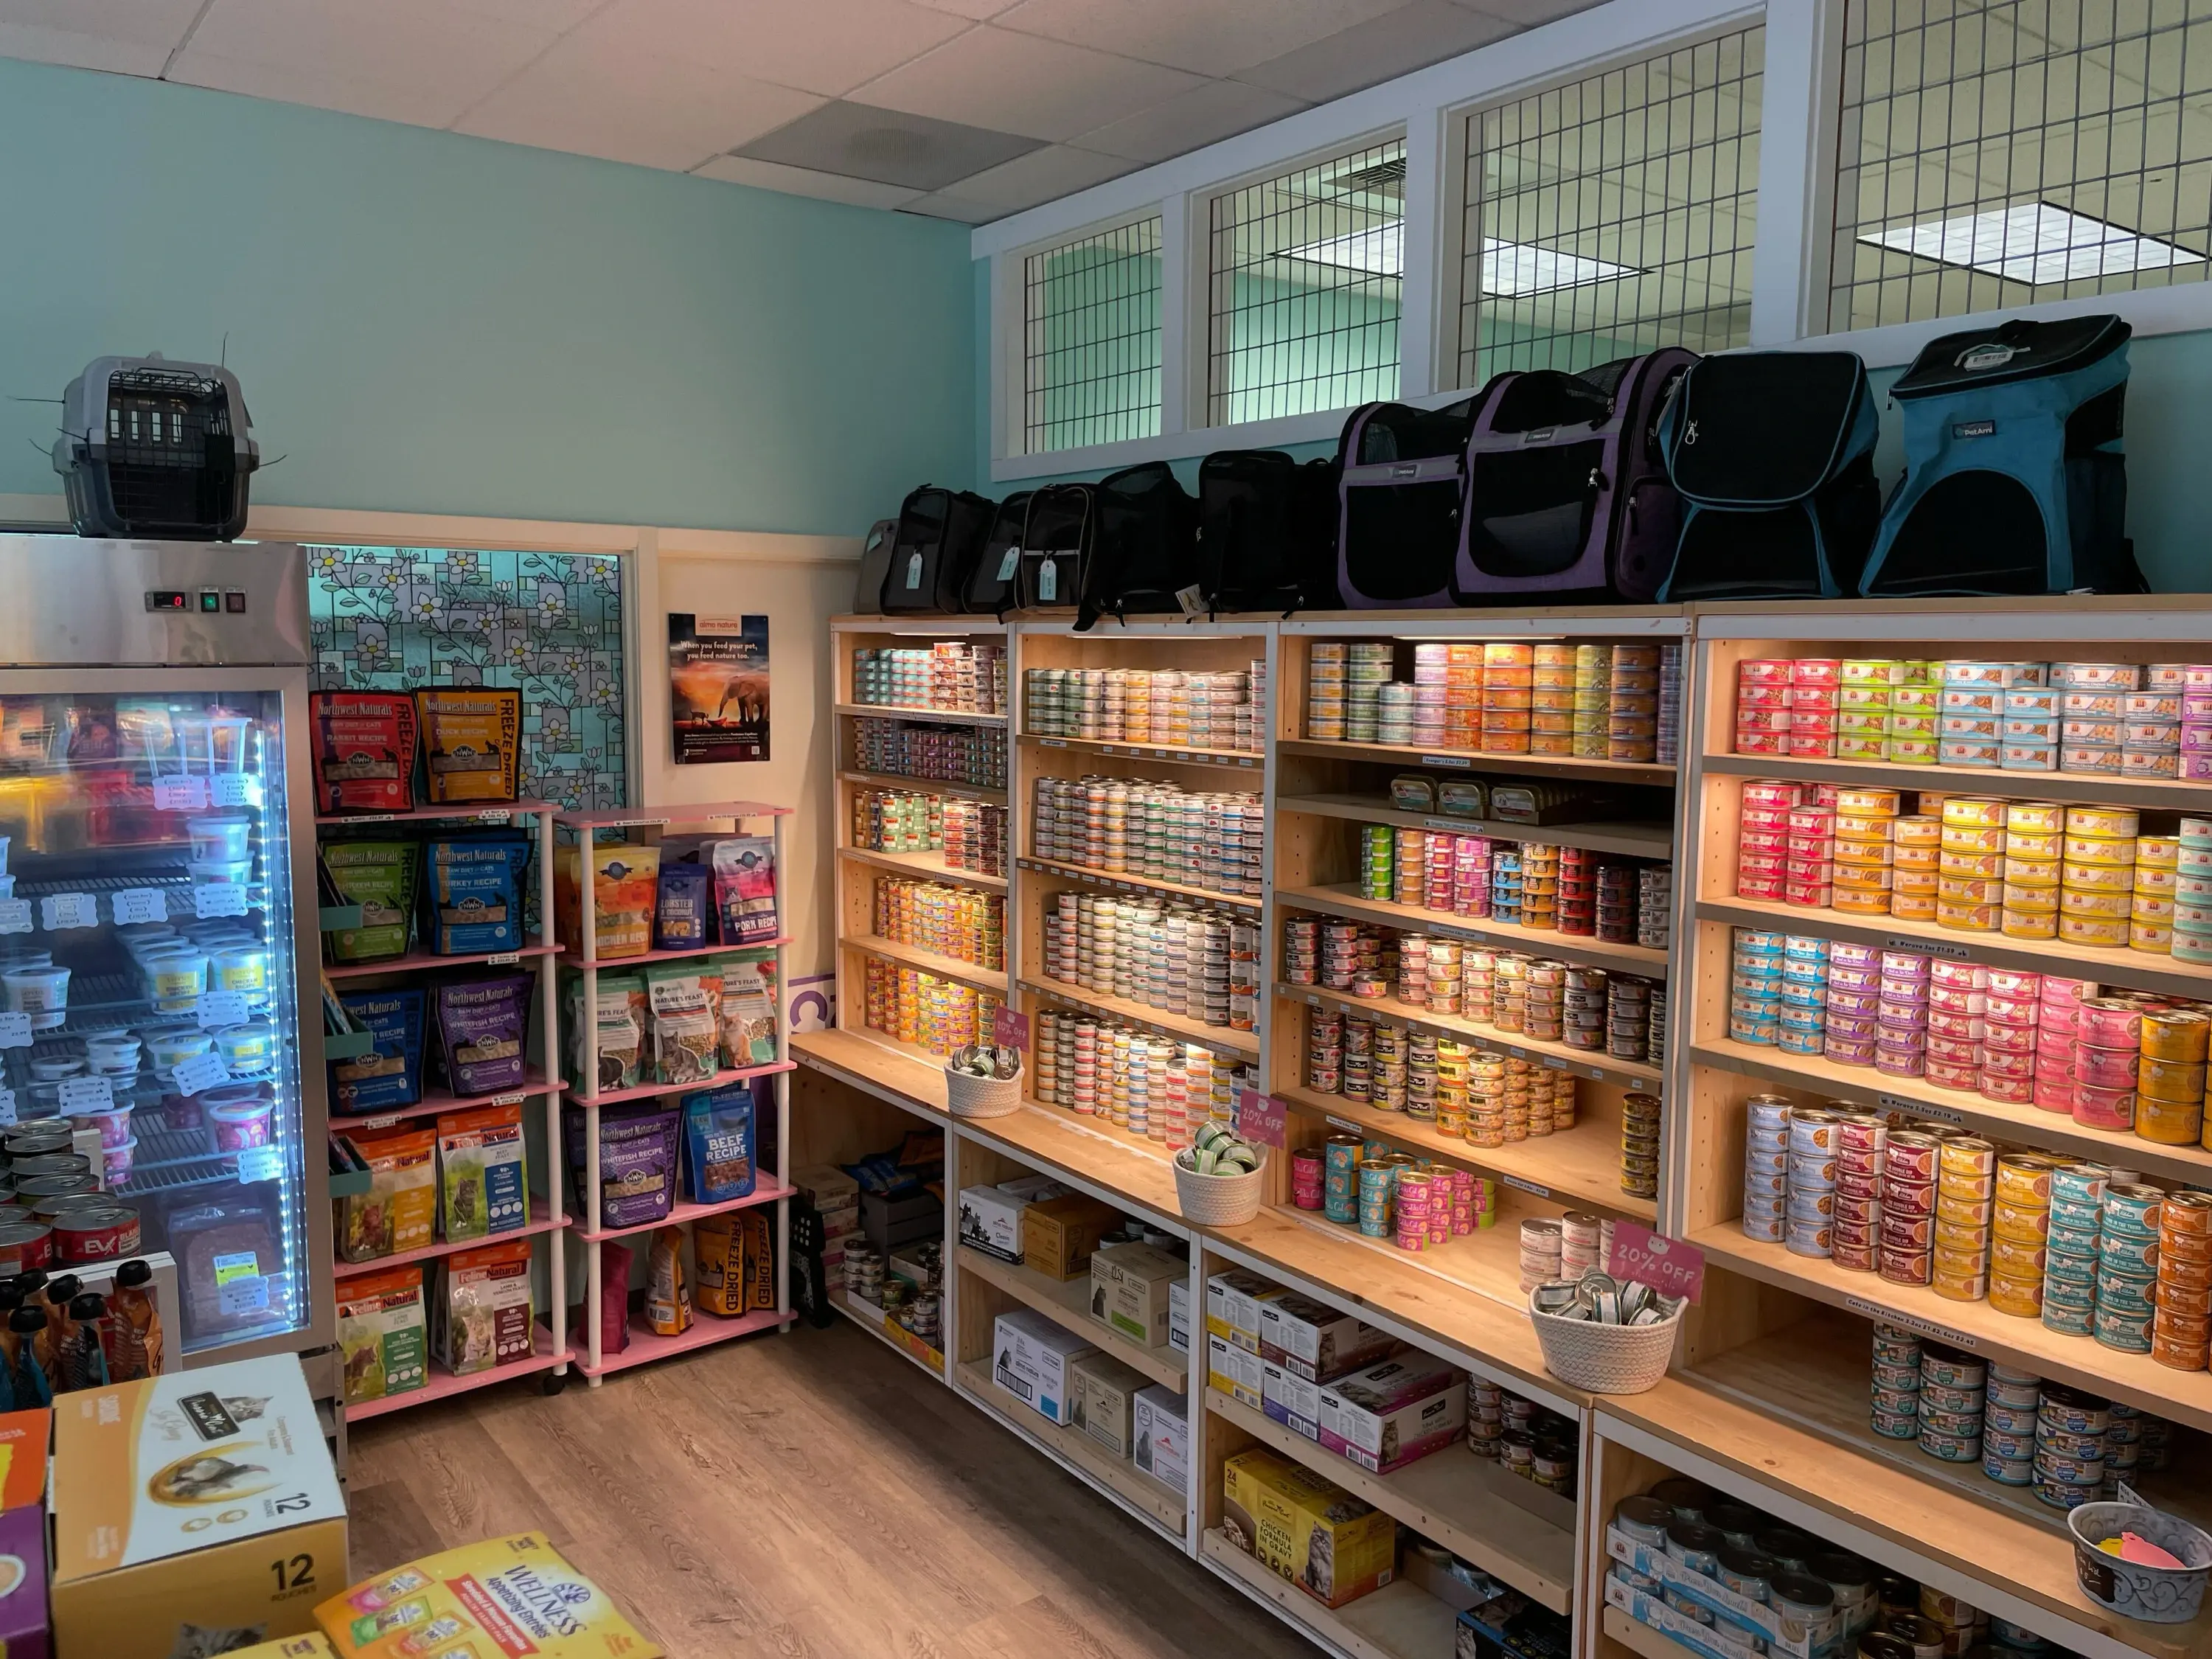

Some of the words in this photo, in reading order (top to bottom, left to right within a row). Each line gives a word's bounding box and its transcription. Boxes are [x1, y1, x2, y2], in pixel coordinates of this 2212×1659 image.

[1965, 425, 1993, 437] PetAmi
[681, 641, 699, 650] When
[701, 642, 712, 651] you
[714, 641, 728, 650] feed
[729, 644, 743, 652] your
[687, 653, 698, 661] you
[700, 651, 714, 659] feed
[319, 702, 358, 717] Northwest
[358, 701, 392, 715] Naturals
[425, 699, 461, 712] Northwest
[462, 698, 496, 712] Naturals
[500, 698, 515, 751] FREEZE
[327, 734, 355, 742] RABBIT
[358, 734, 388, 742] RECIPE
[502, 752, 513, 796] DRIED
[330, 850, 365, 865] Northwest
[366, 849, 398, 863] Naturals
[435, 849, 473, 863] Northwest
[474, 849, 507, 861] Naturals
[473, 877, 502, 886] RECIPE
[661, 899, 693, 908] LOBSTER
[735, 920, 757, 933] PORK
[448, 992, 484, 1006] Northwest
[485, 985, 513, 1001] Naturals
[655, 995, 684, 1004] NATURE'S
[369, 999, 401, 1014] Naturals
[450, 1019, 487, 1029] WHITEFISH
[488, 1013, 516, 1023] RECIPE
[998, 1020, 1013, 1035] 20%
[1014, 1026, 1027, 1039] OFF
[378, 1028, 405, 1038] RECIPE
[1242, 1108, 1262, 1126] 20%
[1265, 1116, 1283, 1132] OFF
[456, 1135, 482, 1149] Feline
[483, 1130, 518, 1144] Natural
[600, 1127, 633, 1141] Northwest
[635, 1121, 661, 1136] Naturals
[709, 1133, 744, 1150] BEEF
[396, 1152, 431, 1167] Natural
[601, 1151, 638, 1165] WHITEFISH
[639, 1147, 664, 1158] RECIPE
[706, 1144, 747, 1161] RECIPE
[727, 1220, 742, 1267] FREEZE
[757, 1220, 770, 1262] FREEZE
[460, 1272, 487, 1284] Feline
[487, 1262, 521, 1280] Natural
[1618, 1244, 1655, 1270] 20%
[1662, 1262, 1695, 1283] OFF
[726, 1270, 738, 1312] DRIED
[757, 1265, 771, 1305] DRIED
[352, 1300, 380, 1315] Feline
[382, 1290, 418, 1307] Natural
[1848, 1299, 1861, 1308] Cats
[1870, 1306, 1879, 1314] the
[1881, 1310, 1905, 1322] Kitchen
[1227, 1469, 1237, 1482] 24
[276, 1492, 310, 1514] 12
[1260, 1526, 1292, 1552] FORMULA
[1261, 1519, 1292, 1543] CHICKEN
[1259, 1534, 1267, 1543] IN
[1269, 1539, 1292, 1559] GRAVY
[271, 1553, 316, 1591] 12
[269, 1584, 317, 1603] POUCHES
[486, 1576, 526, 1613] Appetizing
[504, 1564, 588, 1636] WELLNESS
